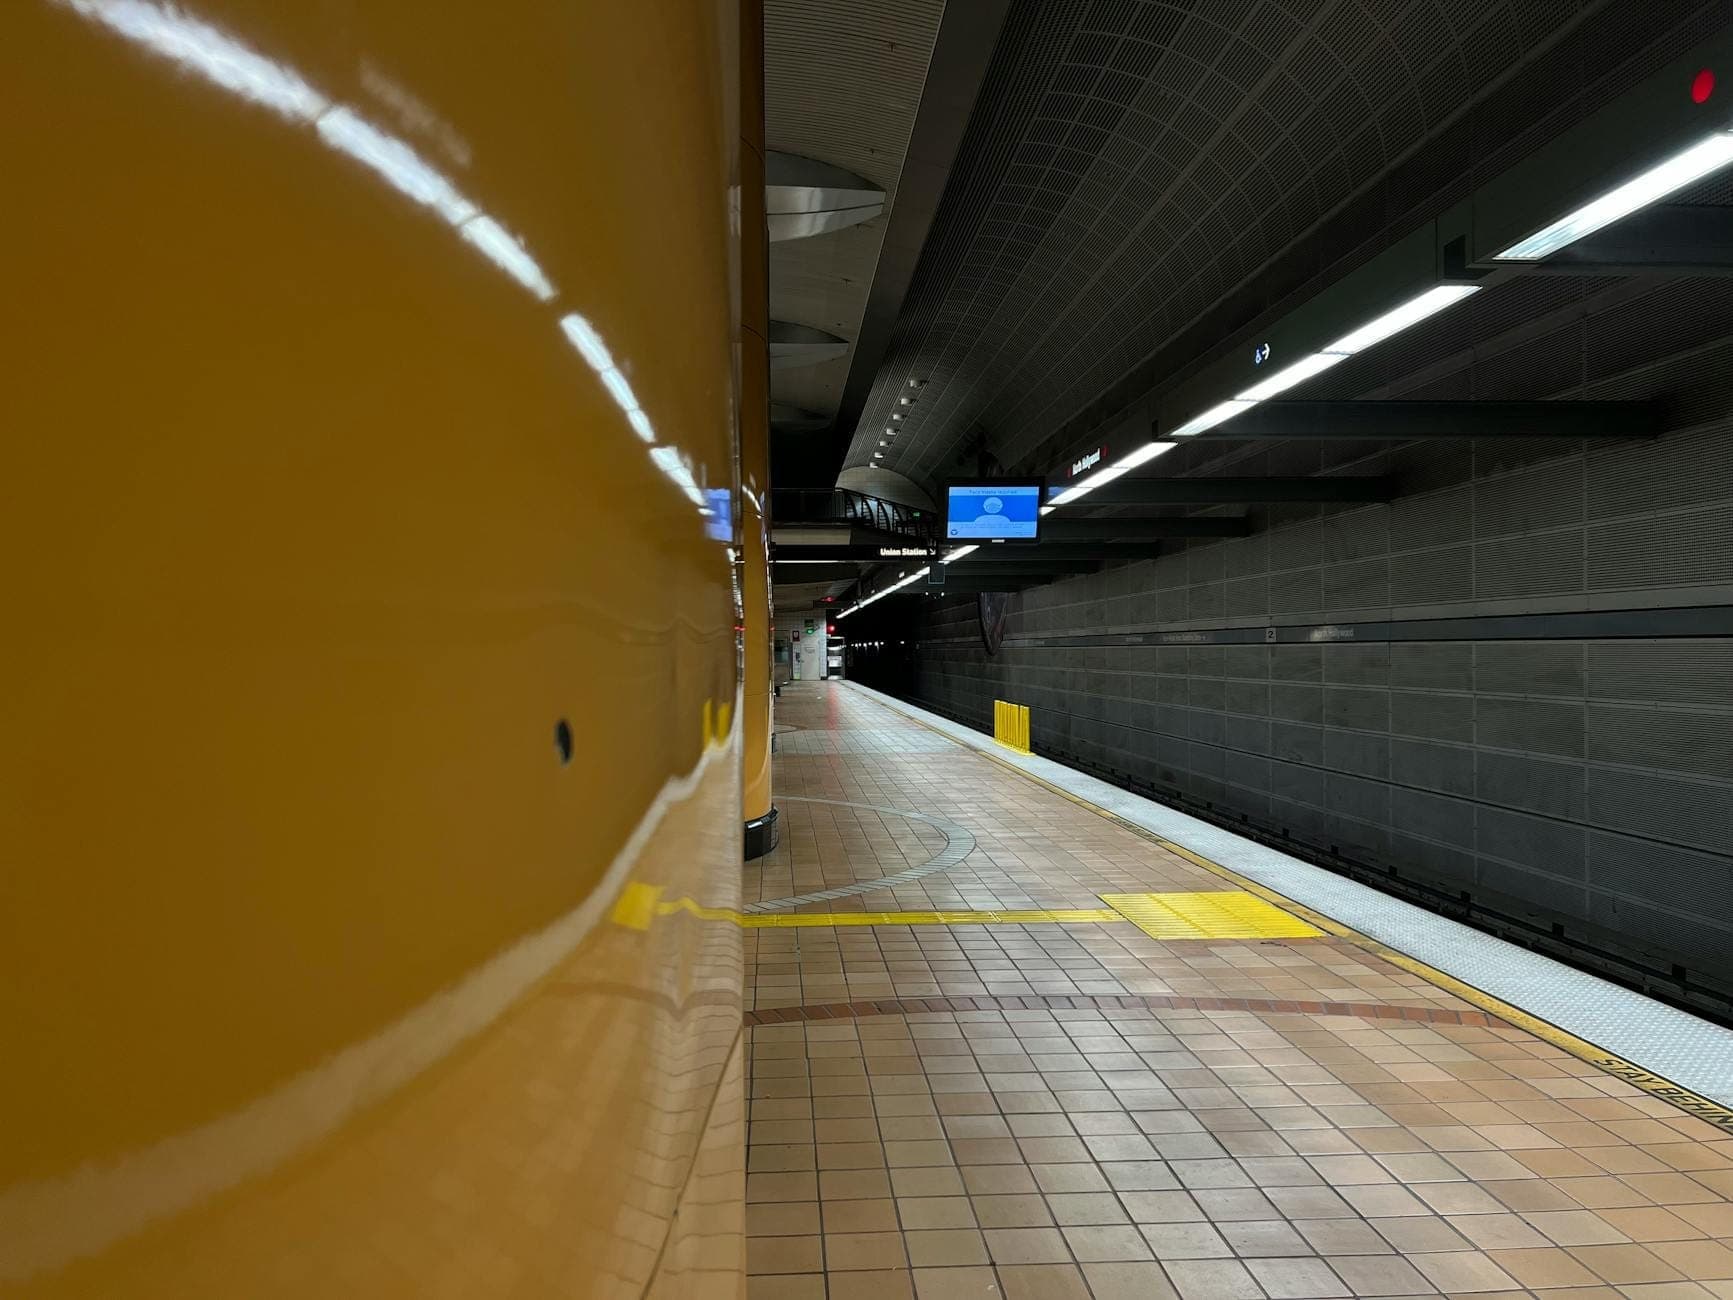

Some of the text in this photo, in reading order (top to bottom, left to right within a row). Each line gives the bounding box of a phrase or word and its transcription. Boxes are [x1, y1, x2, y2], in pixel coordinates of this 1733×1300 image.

[879, 547, 928, 556] Union Station
[1267, 630, 1275, 639] 2
[1593, 1059, 1664, 1087] STAY
